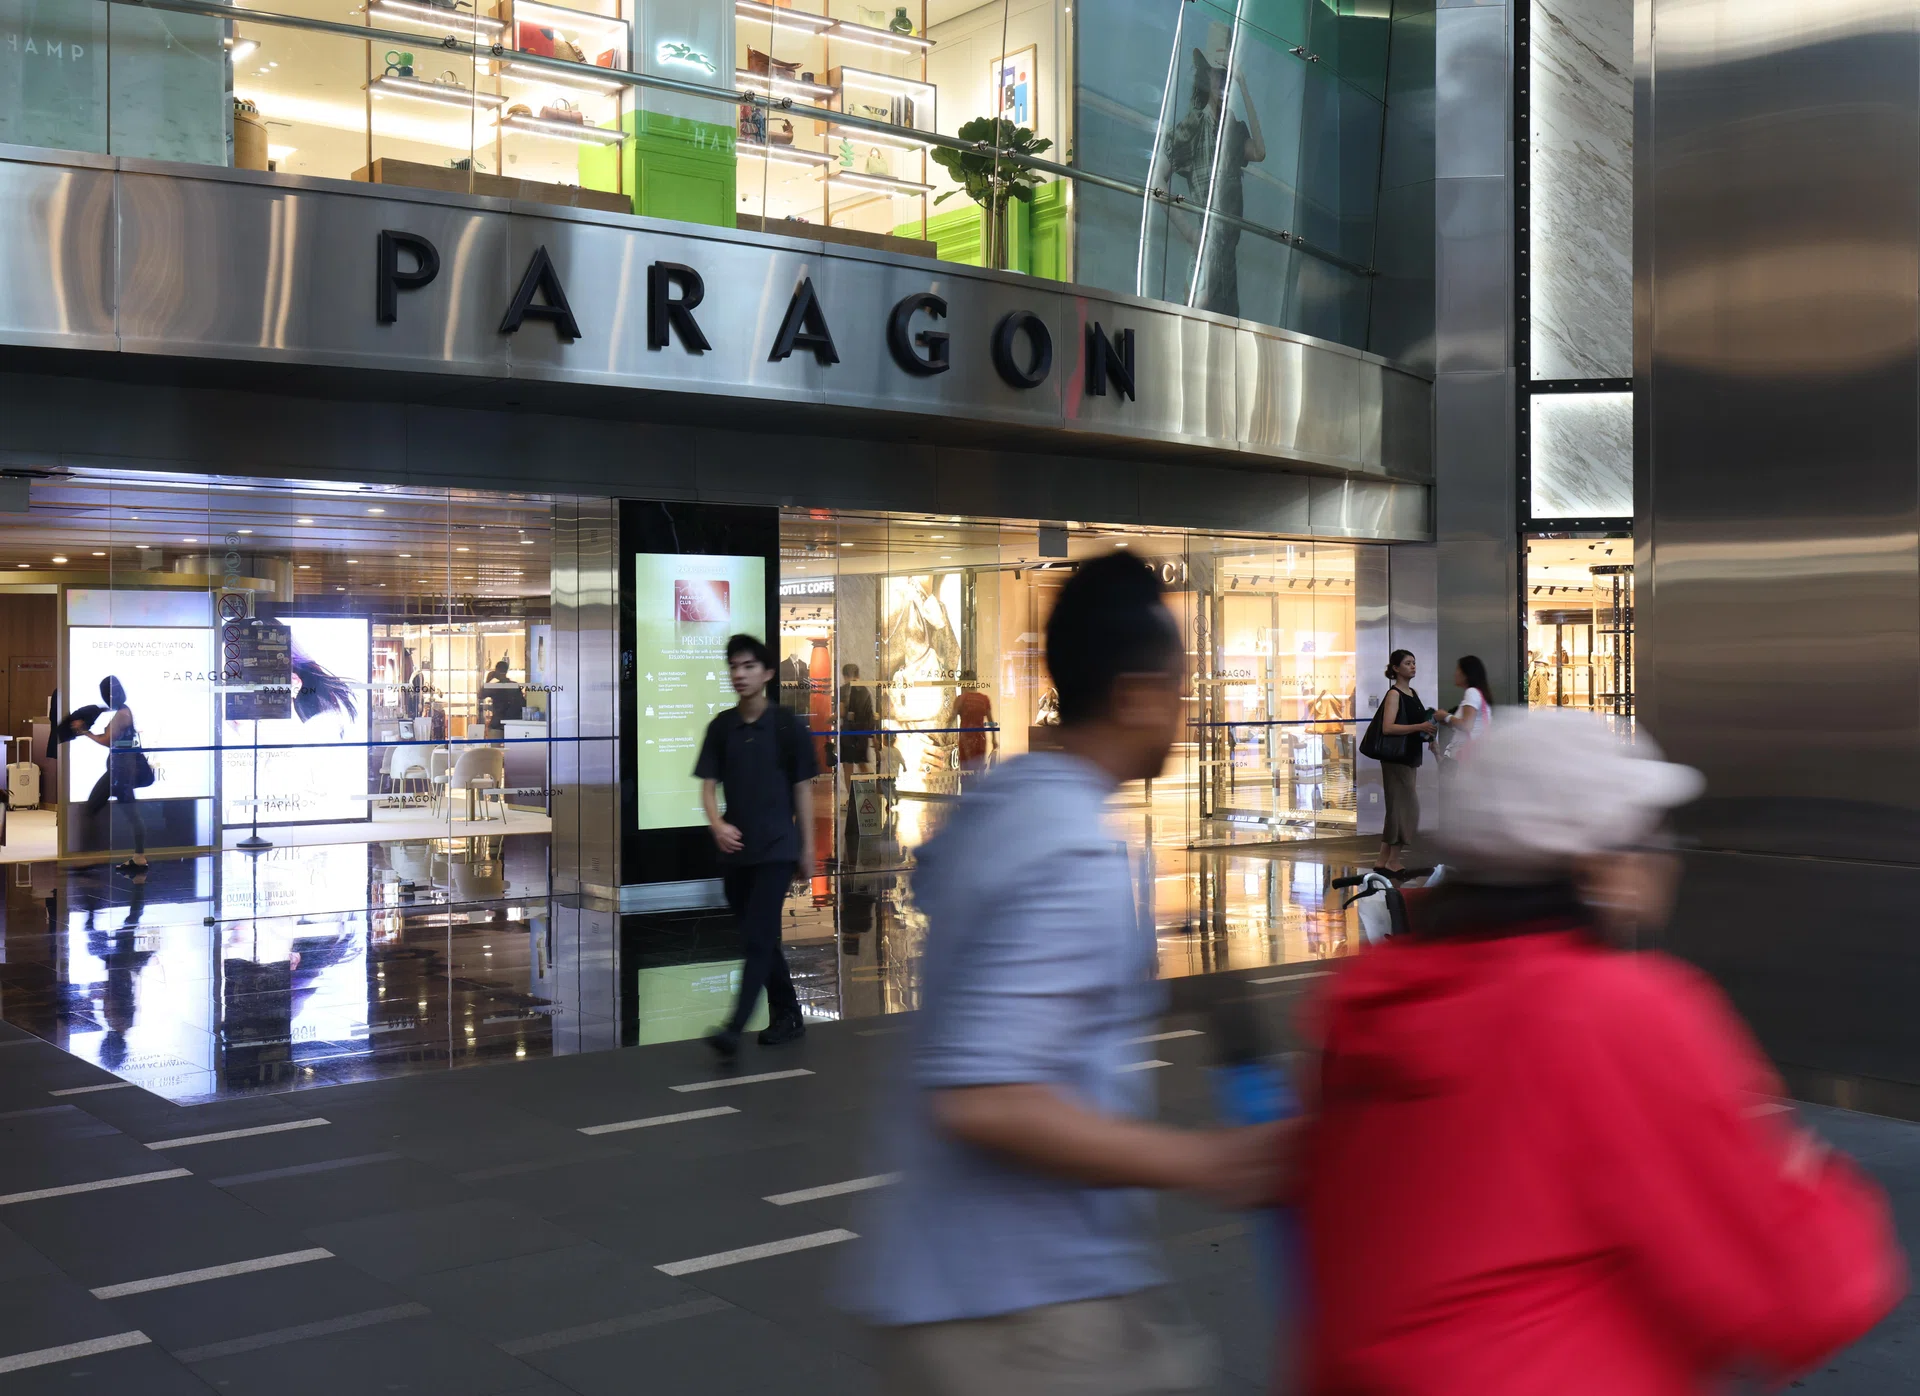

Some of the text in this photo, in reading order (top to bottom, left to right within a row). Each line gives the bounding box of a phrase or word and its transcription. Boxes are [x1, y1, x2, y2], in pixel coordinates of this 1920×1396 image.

[377, 229, 1136, 402] PARAGON
[682, 635, 725, 646] PRESTIGE
[920, 669, 970, 679] PARAGON
[1212, 669, 1251, 678] PARAGON
[263, 685, 317, 696] PARAGON
[387, 685, 436, 694] PARAGON
[518, 684, 564, 693] PARAGON
[957, 682, 992, 690] PARAGON
[517, 788, 563, 798] PARAGON
[388, 795, 437, 804] PARAGON
